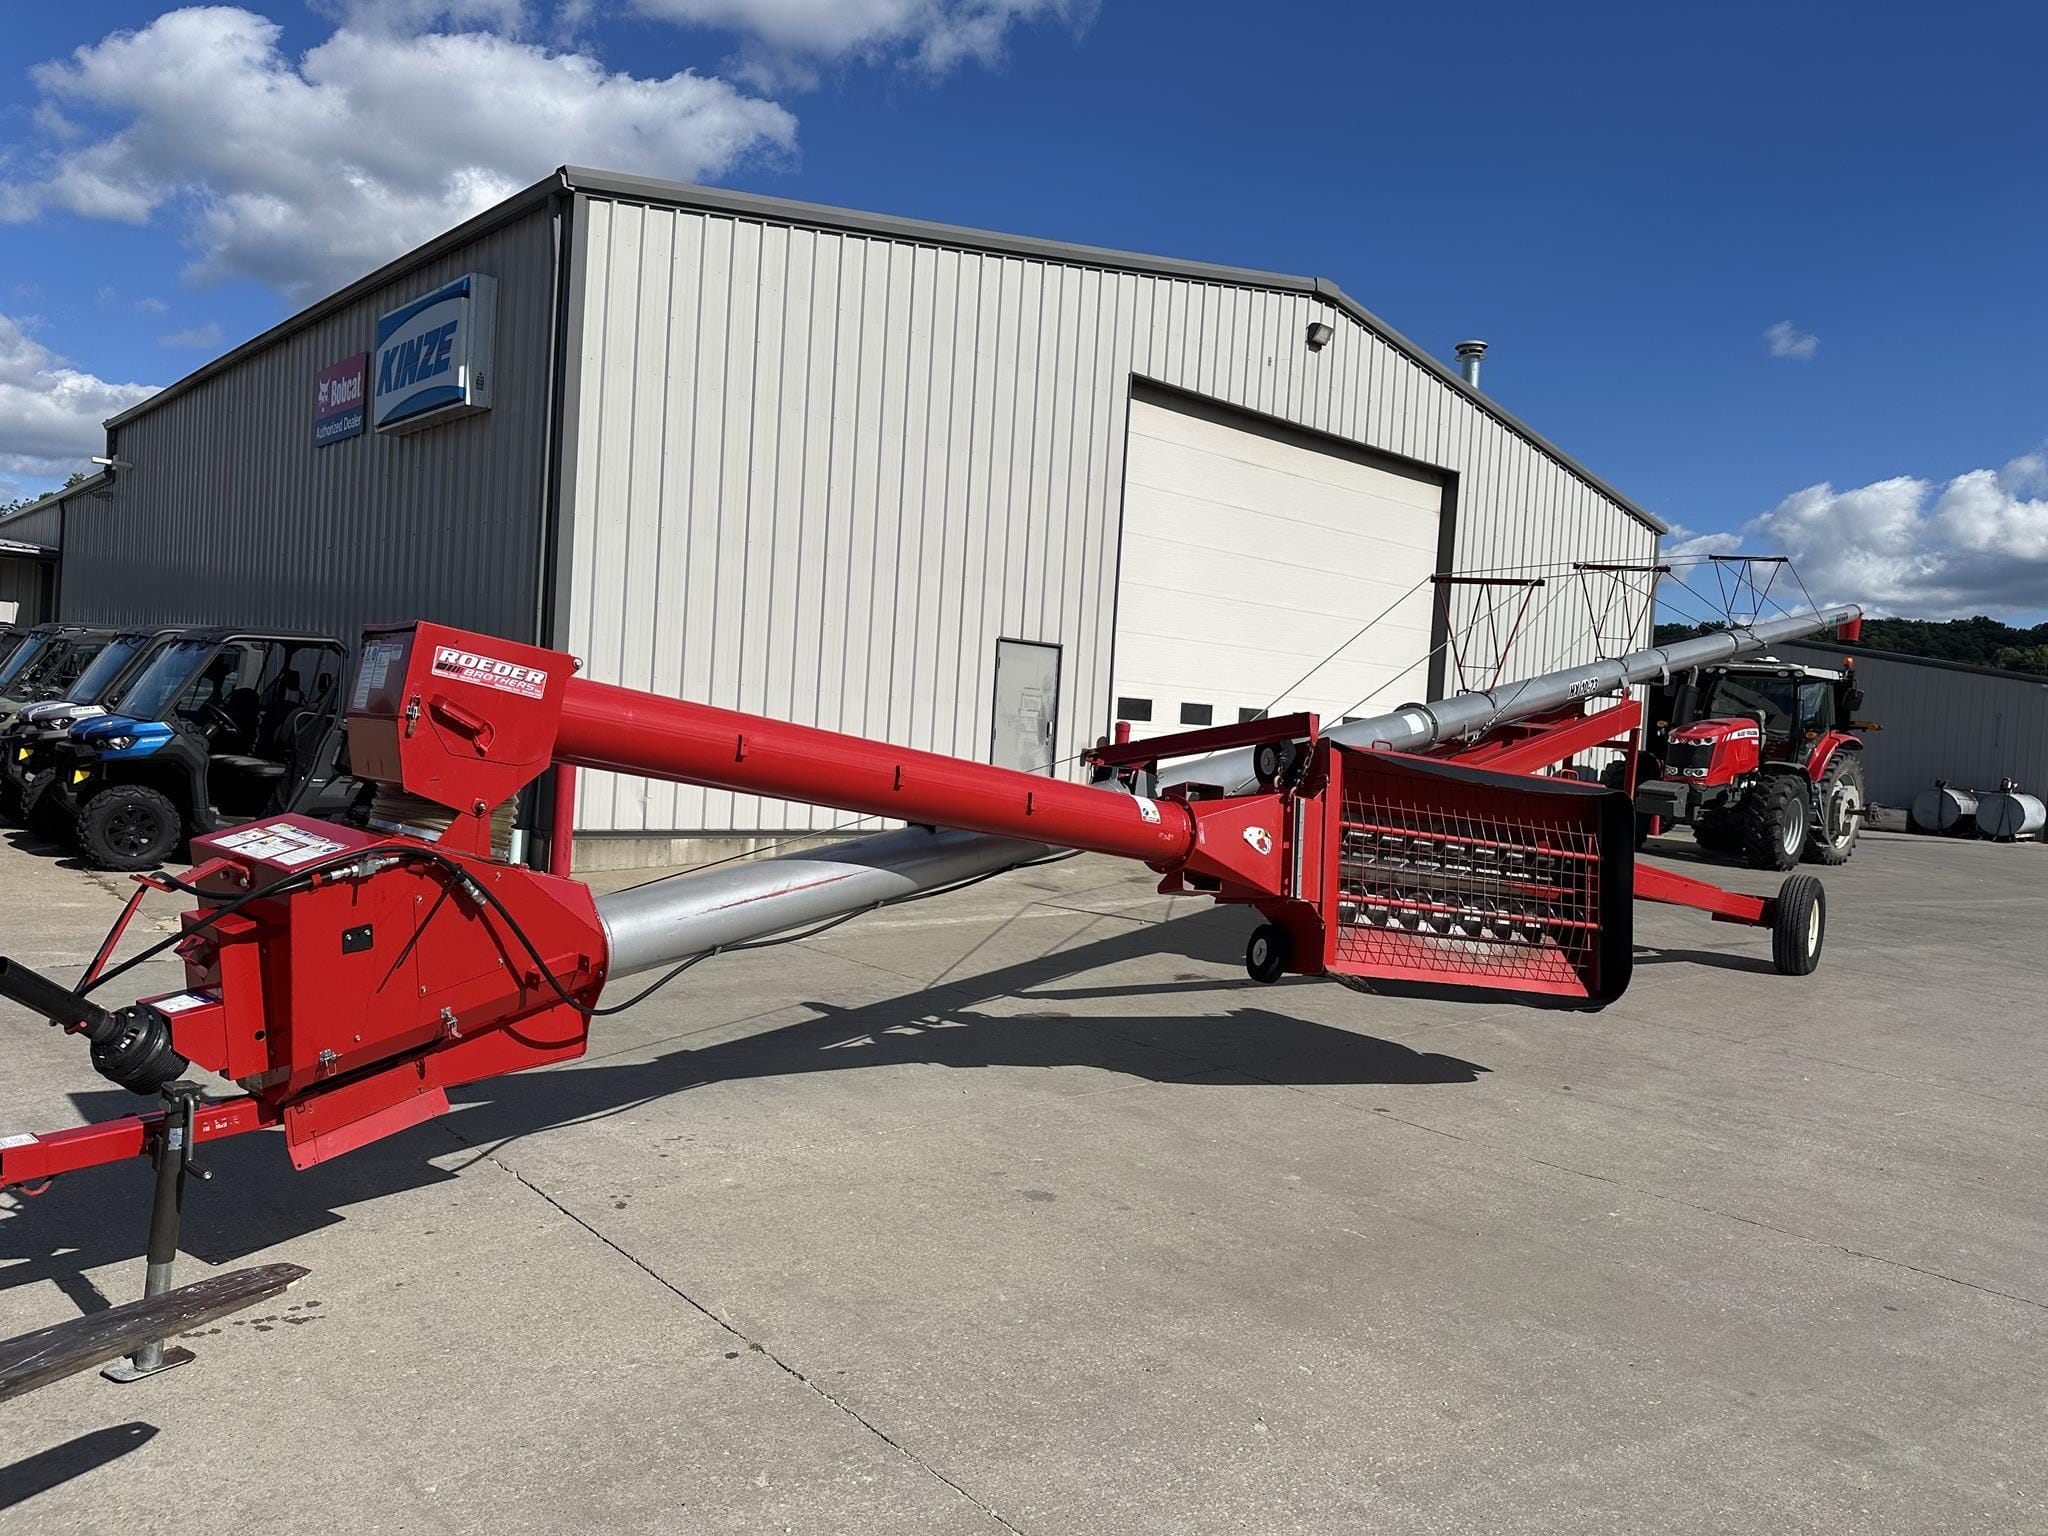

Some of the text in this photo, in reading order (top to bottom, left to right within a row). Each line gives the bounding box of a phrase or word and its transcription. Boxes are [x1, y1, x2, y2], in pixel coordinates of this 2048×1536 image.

[376, 319, 459, 397] KINZE
[330, 371, 361, 407] Bobcat
[315, 413, 362, 440] Authorized Dealer
[438, 649, 545, 685] ROEDER
[463, 668, 537, 691] BROTHERS
